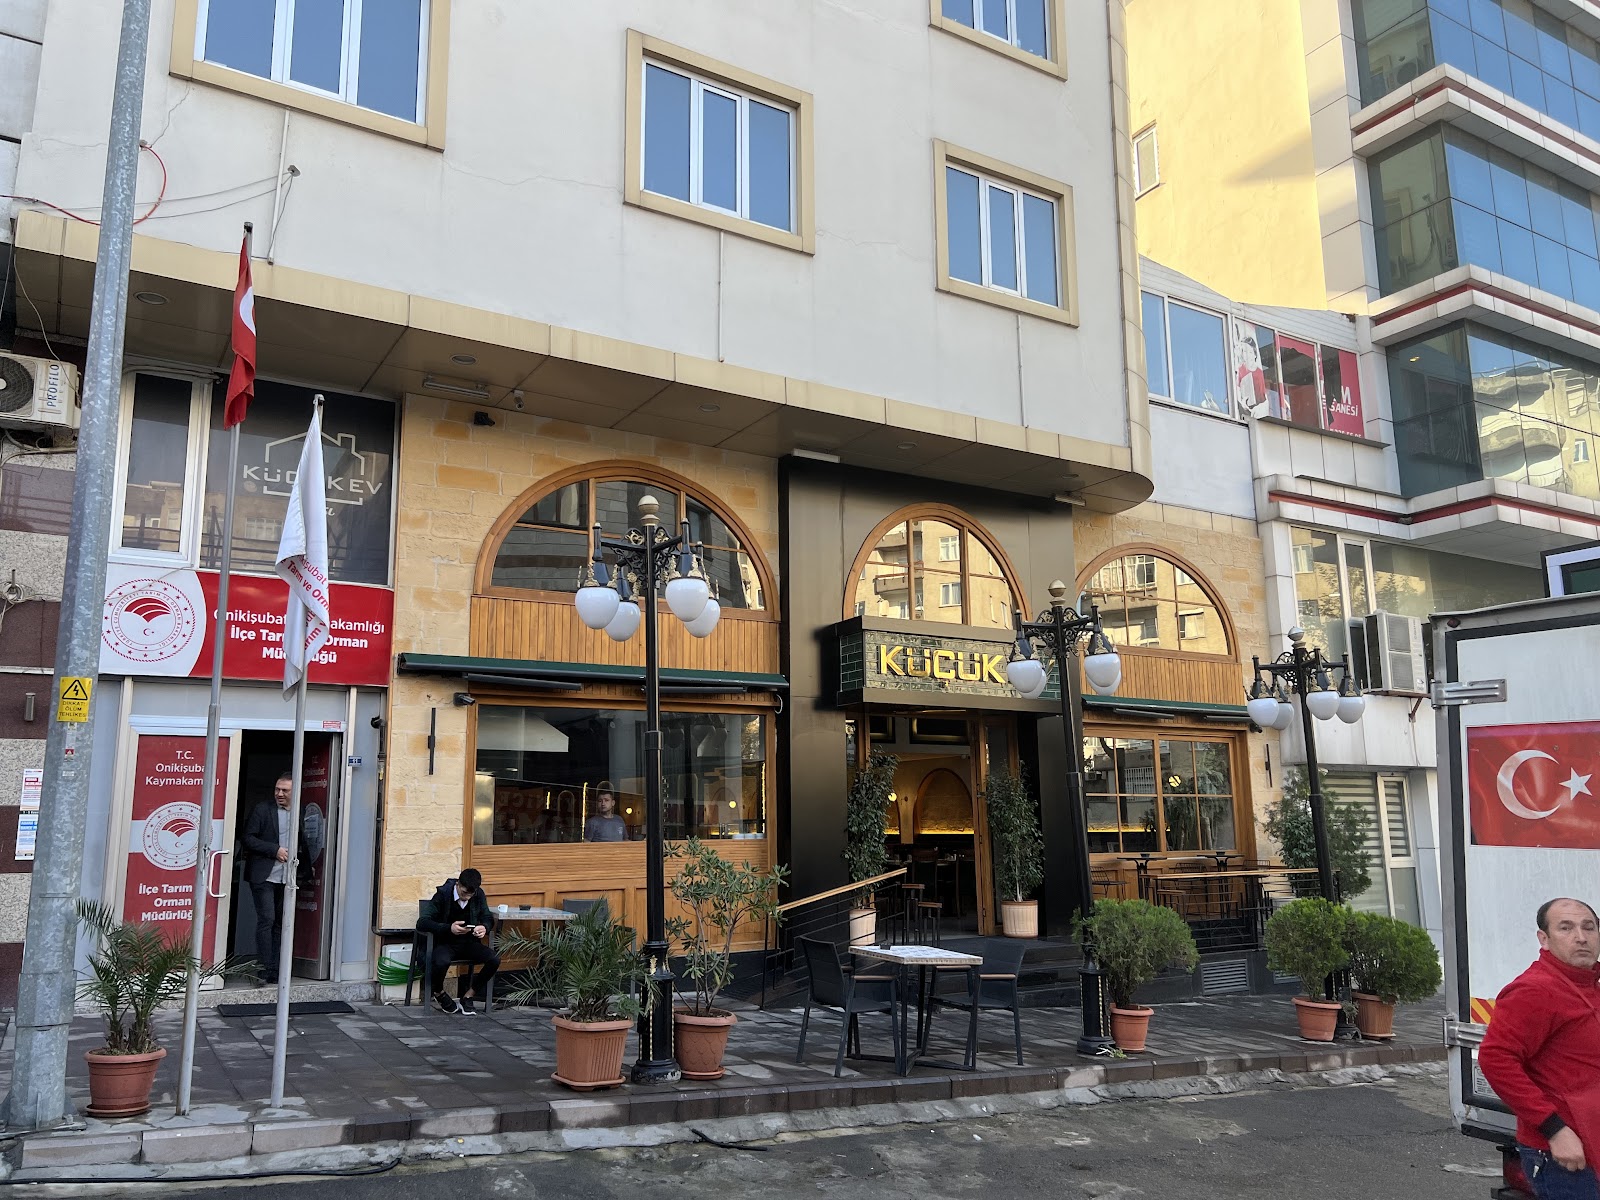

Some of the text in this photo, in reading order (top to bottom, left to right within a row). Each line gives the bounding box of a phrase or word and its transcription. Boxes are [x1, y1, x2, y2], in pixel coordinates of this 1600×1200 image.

[302, 579, 312, 592] ve
[312, 589, 330, 611] Orm
[329, 618, 386, 636] akamlığı
[230, 624, 369, 649] İlçe Tarı Orman
[175, 750, 194, 760] T.C.
[155, 763, 205, 774] Onikişuba
[145, 776, 220, 787] Kaymakamı
[138, 883, 193, 896] İlçe Tarım
[153, 898, 193, 908] Orman
[141, 910, 193, 922] Müdürlüğ
